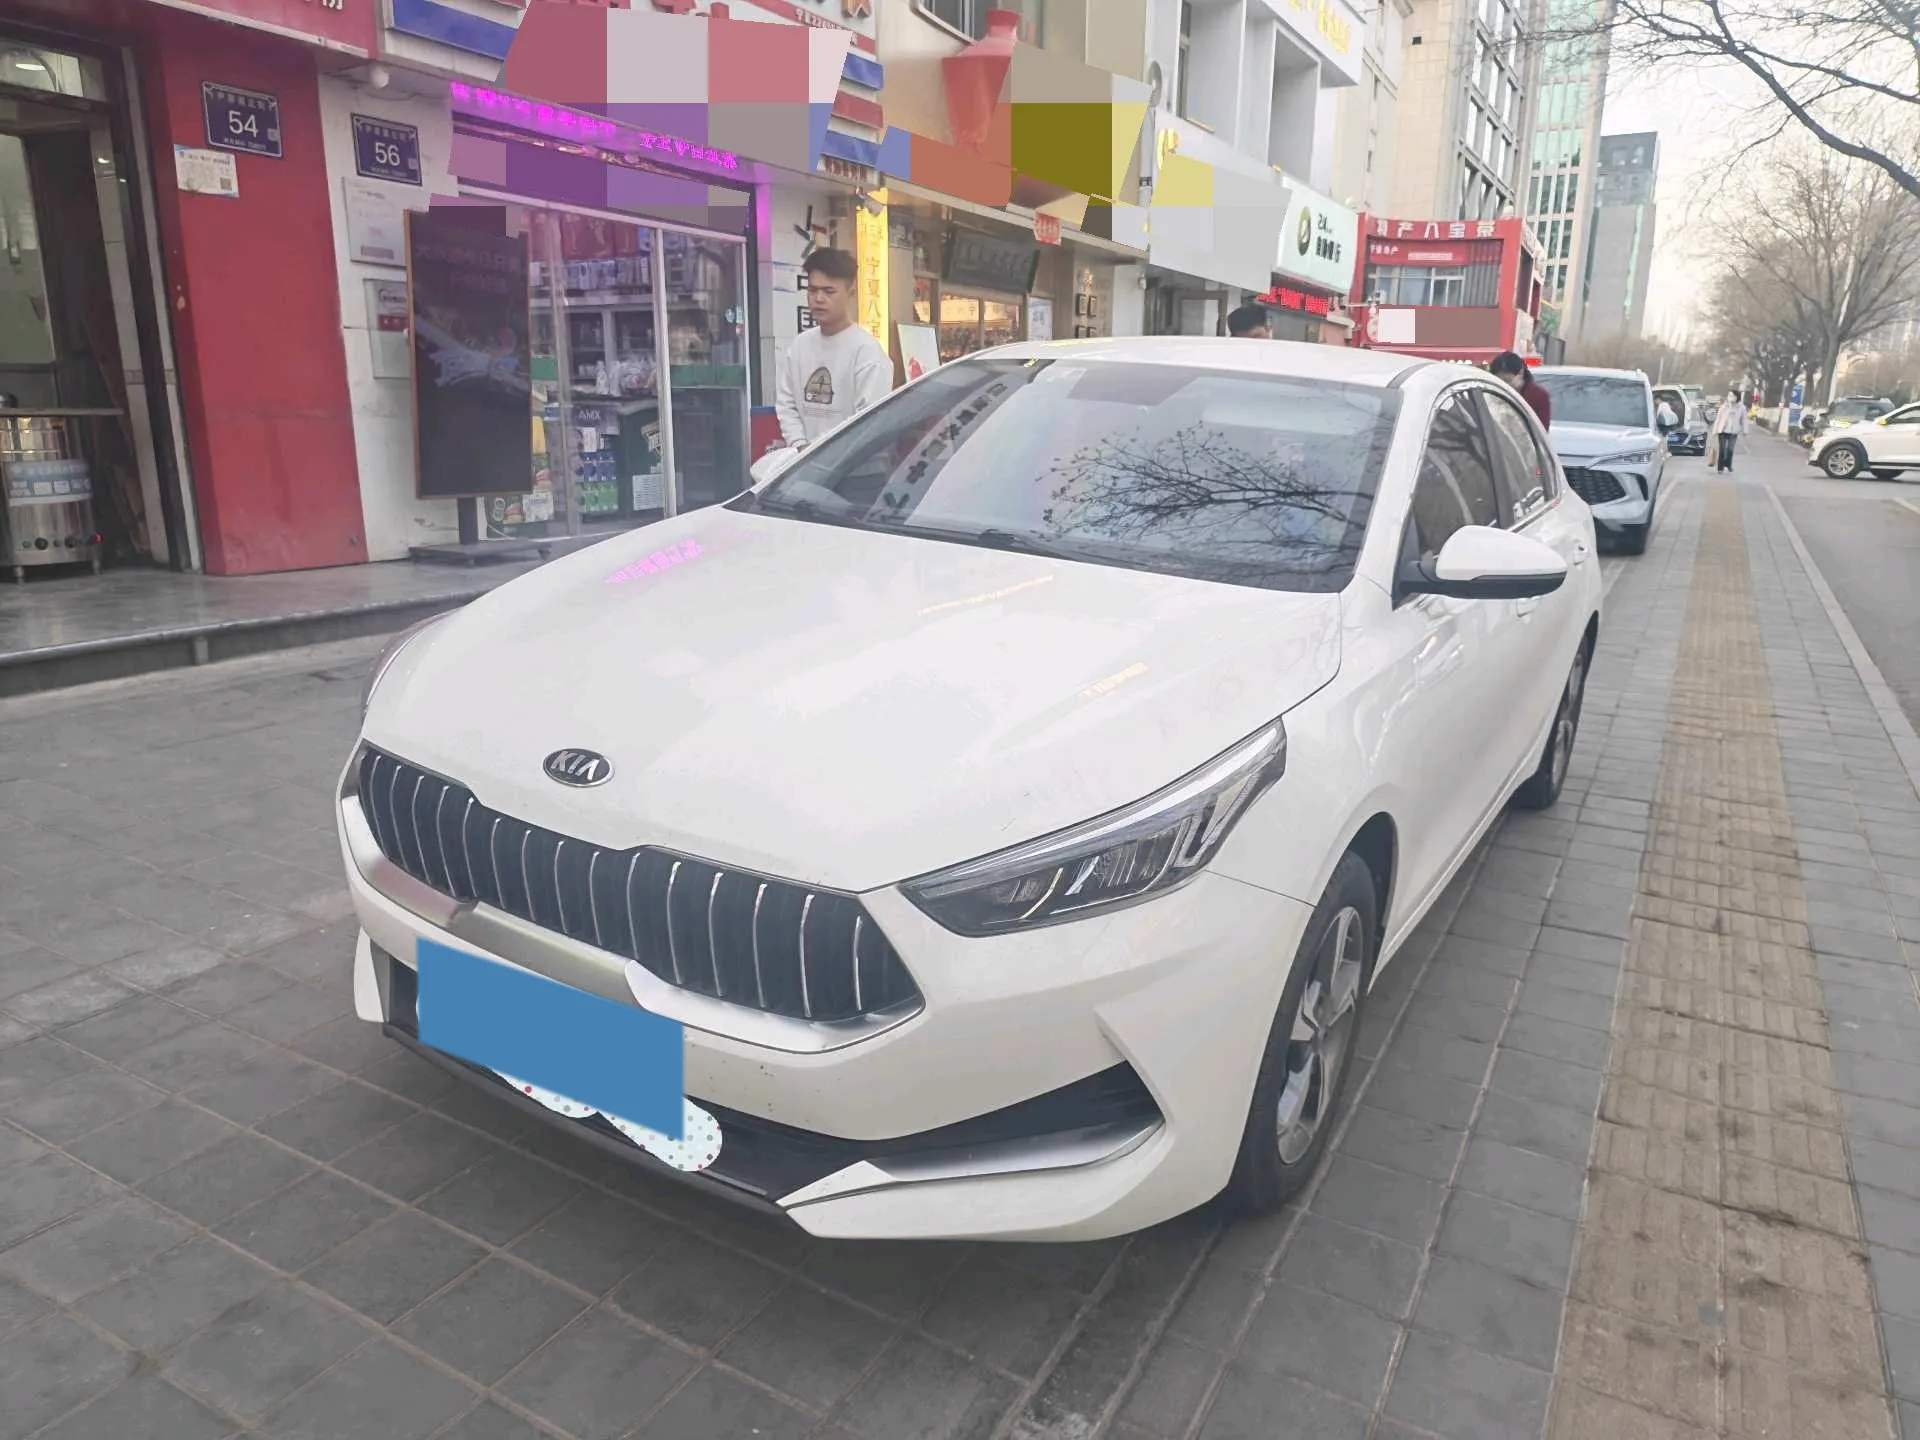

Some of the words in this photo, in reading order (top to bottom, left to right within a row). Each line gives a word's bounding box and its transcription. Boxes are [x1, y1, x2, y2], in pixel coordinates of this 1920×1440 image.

[229, 110, 258, 138] 54
[375, 142, 401, 167] 56
[550, 750, 600, 781] KIA
